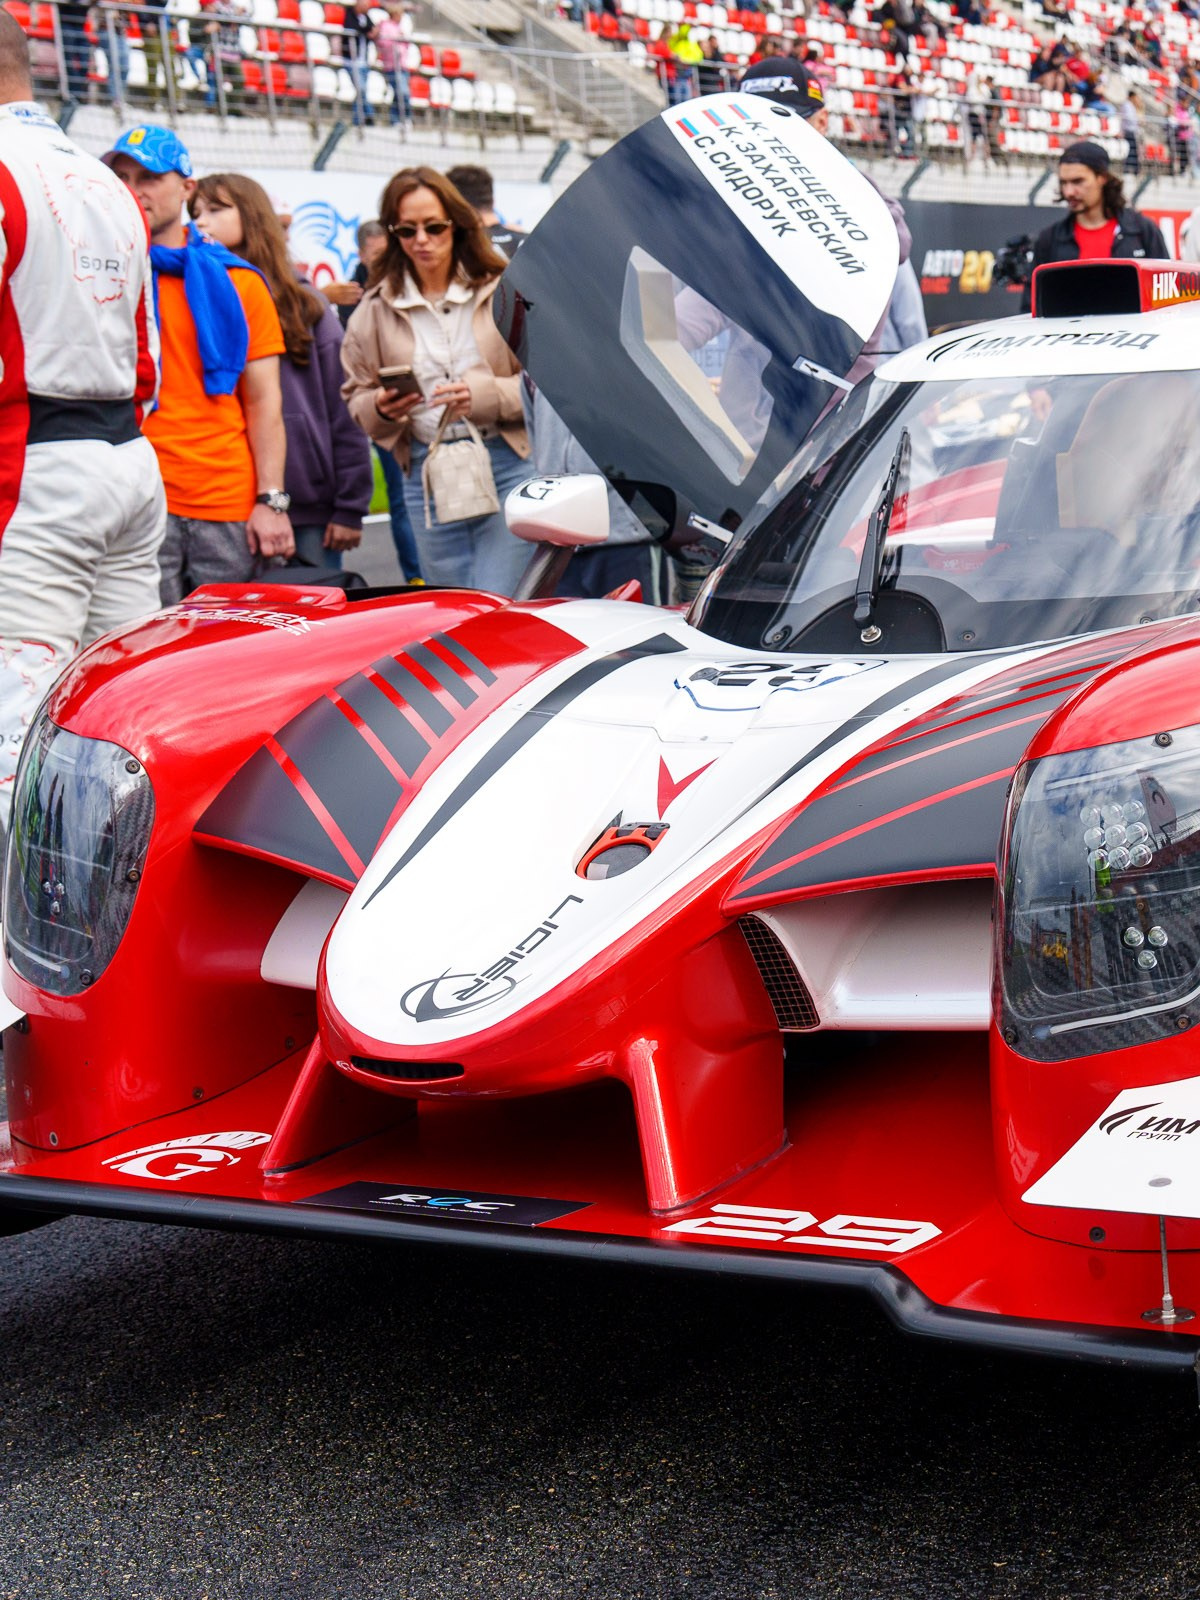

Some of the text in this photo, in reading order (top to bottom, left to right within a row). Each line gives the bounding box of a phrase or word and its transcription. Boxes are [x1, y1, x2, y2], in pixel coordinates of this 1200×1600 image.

[964, 329, 1160, 352] ИМТРЕЙД
[451, 894, 584, 1002] LIGIER
[1127, 1131, 1181, 1142] ГРУПП
[660, 1203, 943, 1253] 29
